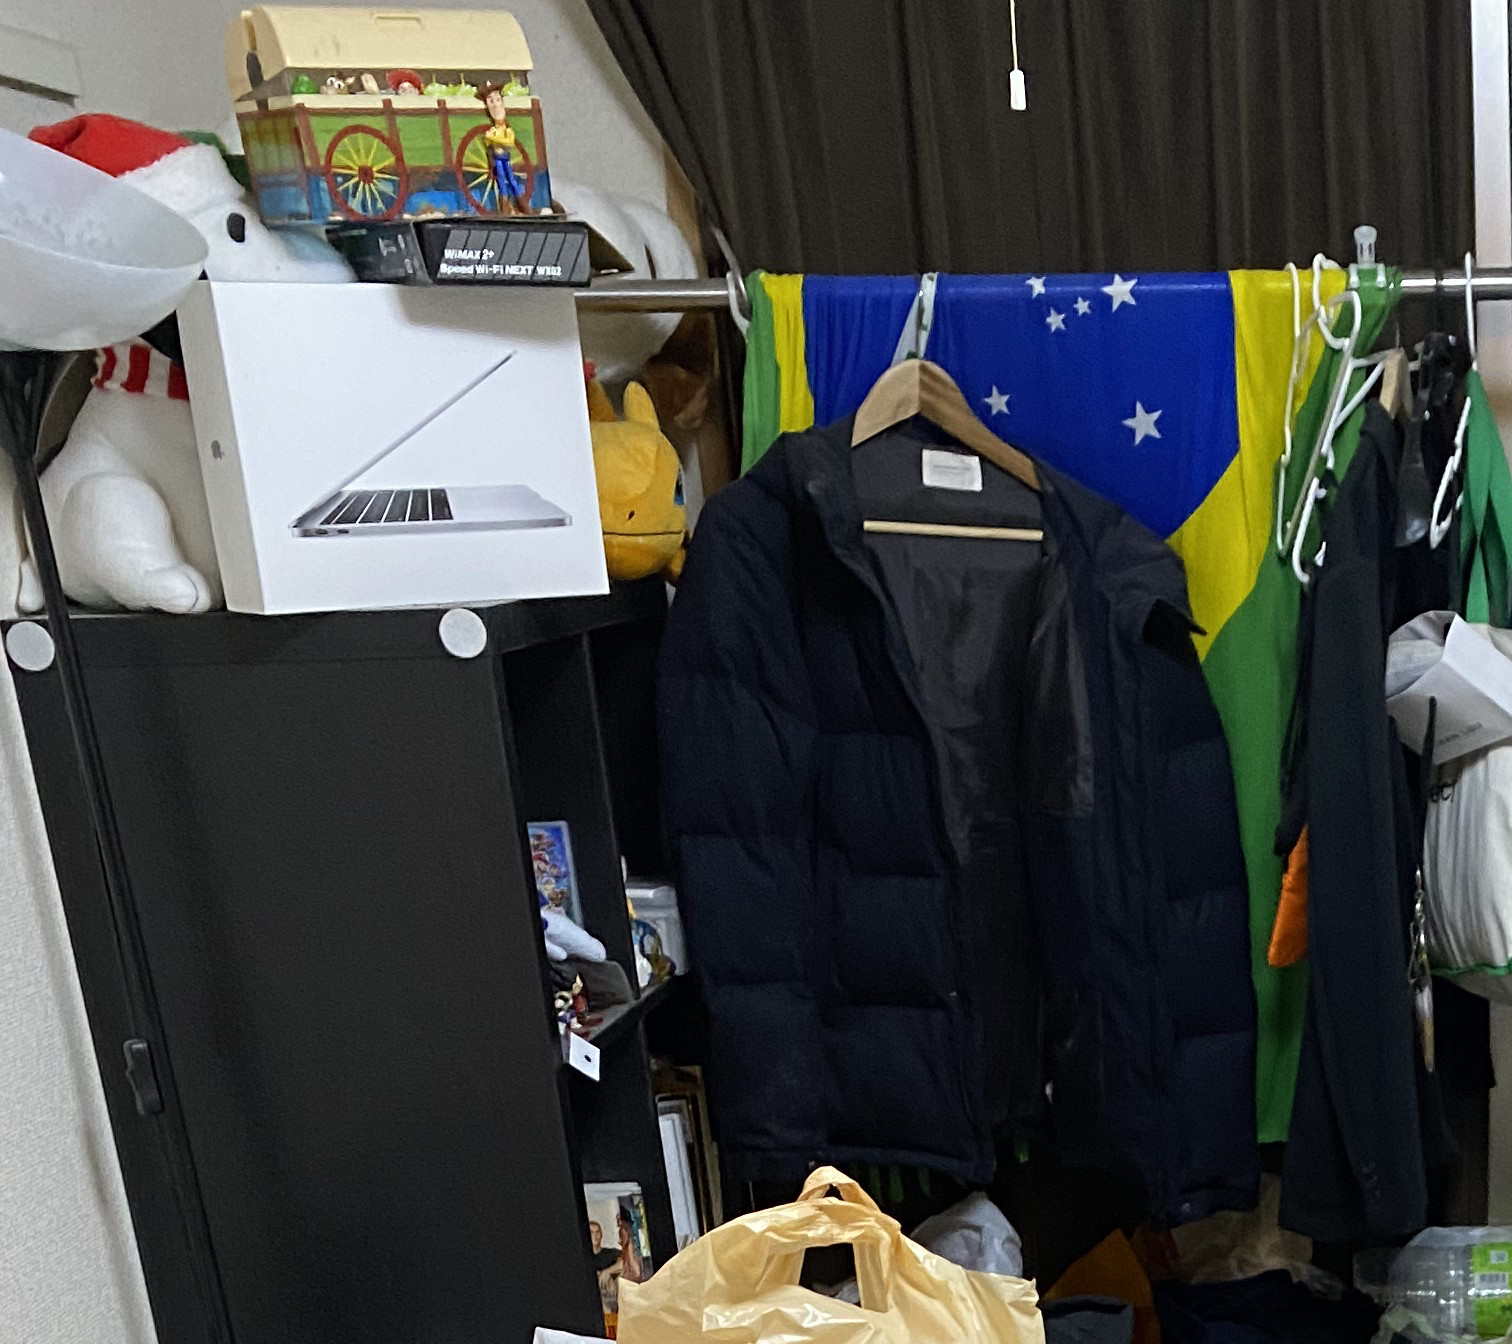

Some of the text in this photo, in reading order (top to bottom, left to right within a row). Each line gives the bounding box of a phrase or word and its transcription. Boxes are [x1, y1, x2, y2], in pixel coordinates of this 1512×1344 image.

[444, 248, 480, 259] WiMAX
[440, 263, 474, 274] Speed
[475, 264, 504, 274] Wi-Fi
[505, 264, 534, 275] NEXT
